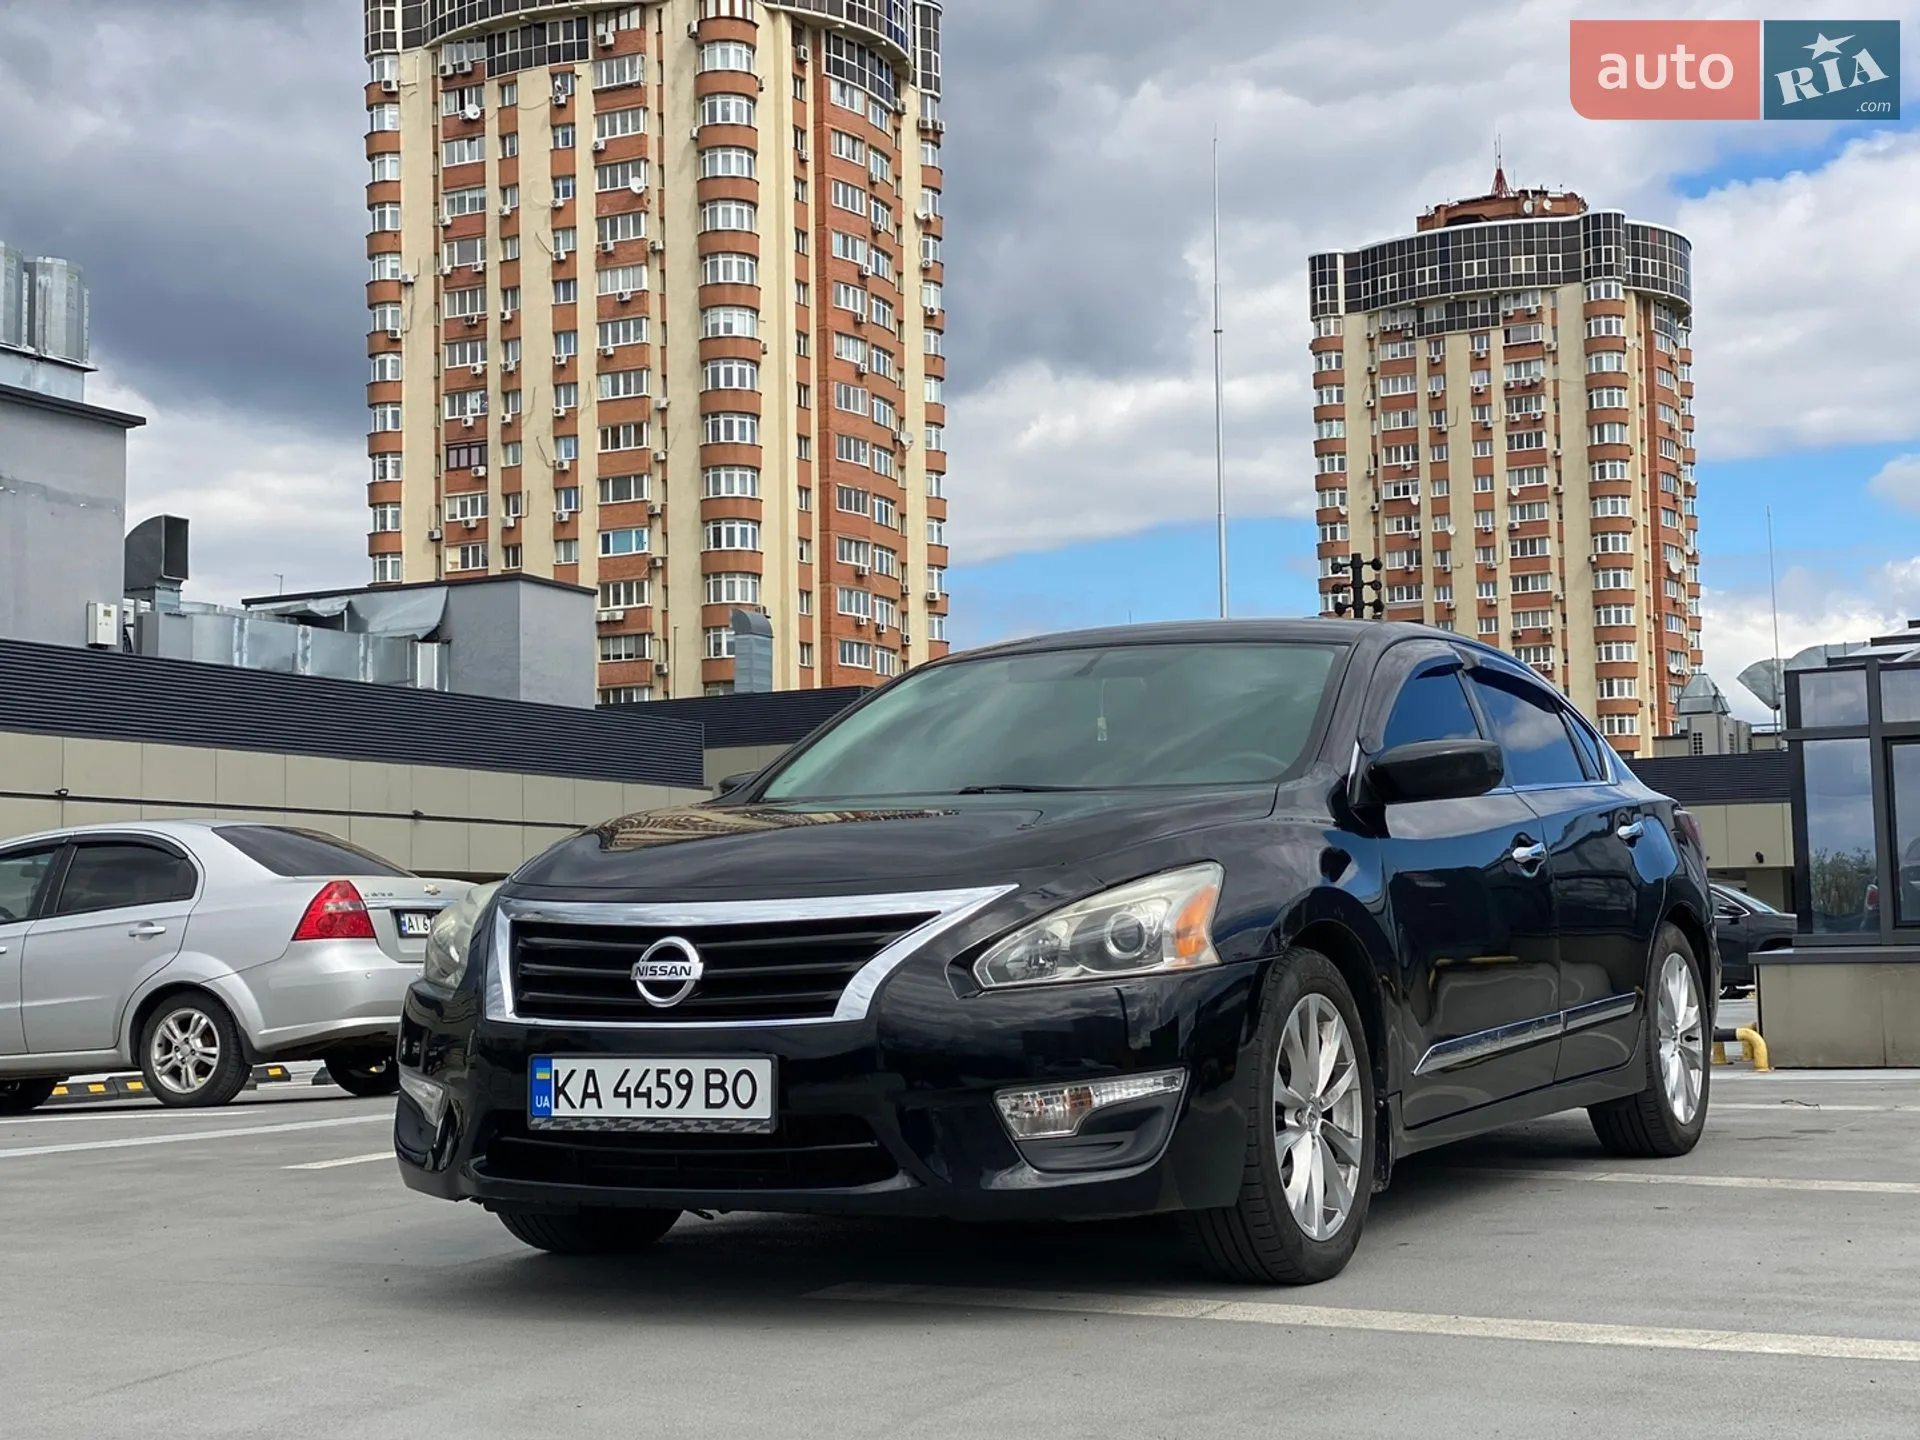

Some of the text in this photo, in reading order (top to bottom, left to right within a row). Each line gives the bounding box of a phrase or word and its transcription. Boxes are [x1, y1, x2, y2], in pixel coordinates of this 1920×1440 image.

[635, 965, 692, 976] NISSAN
[553, 1068, 758, 1110] KA 4459 BO
[535, 1095, 550, 1108] UA
